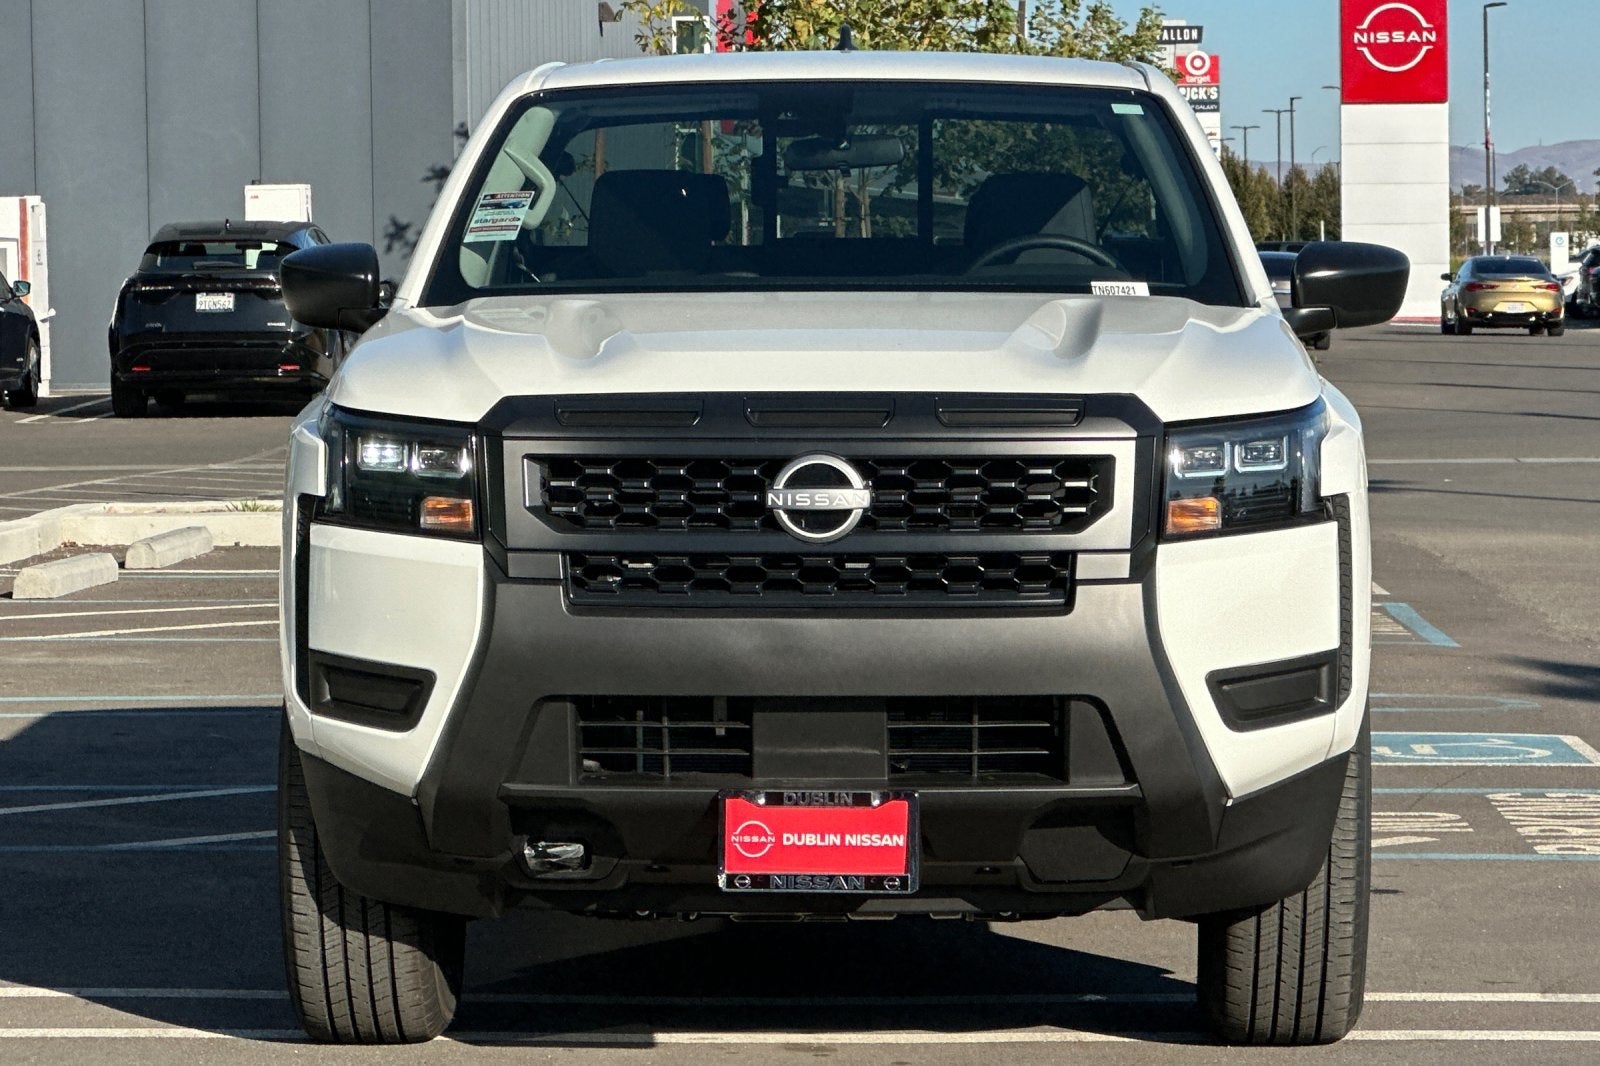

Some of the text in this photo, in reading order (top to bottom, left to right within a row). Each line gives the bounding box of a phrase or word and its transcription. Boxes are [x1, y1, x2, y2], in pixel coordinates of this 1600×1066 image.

[1353, 31, 1436, 43] NISSAN
[1092, 286, 1136, 295] TN607421
[767, 493, 868, 506] NISSAN
[783, 792, 853, 806] DUBLIN
[782, 834, 905, 847] DUBLIN NISSAN
[769, 875, 866, 890] NISSAN
